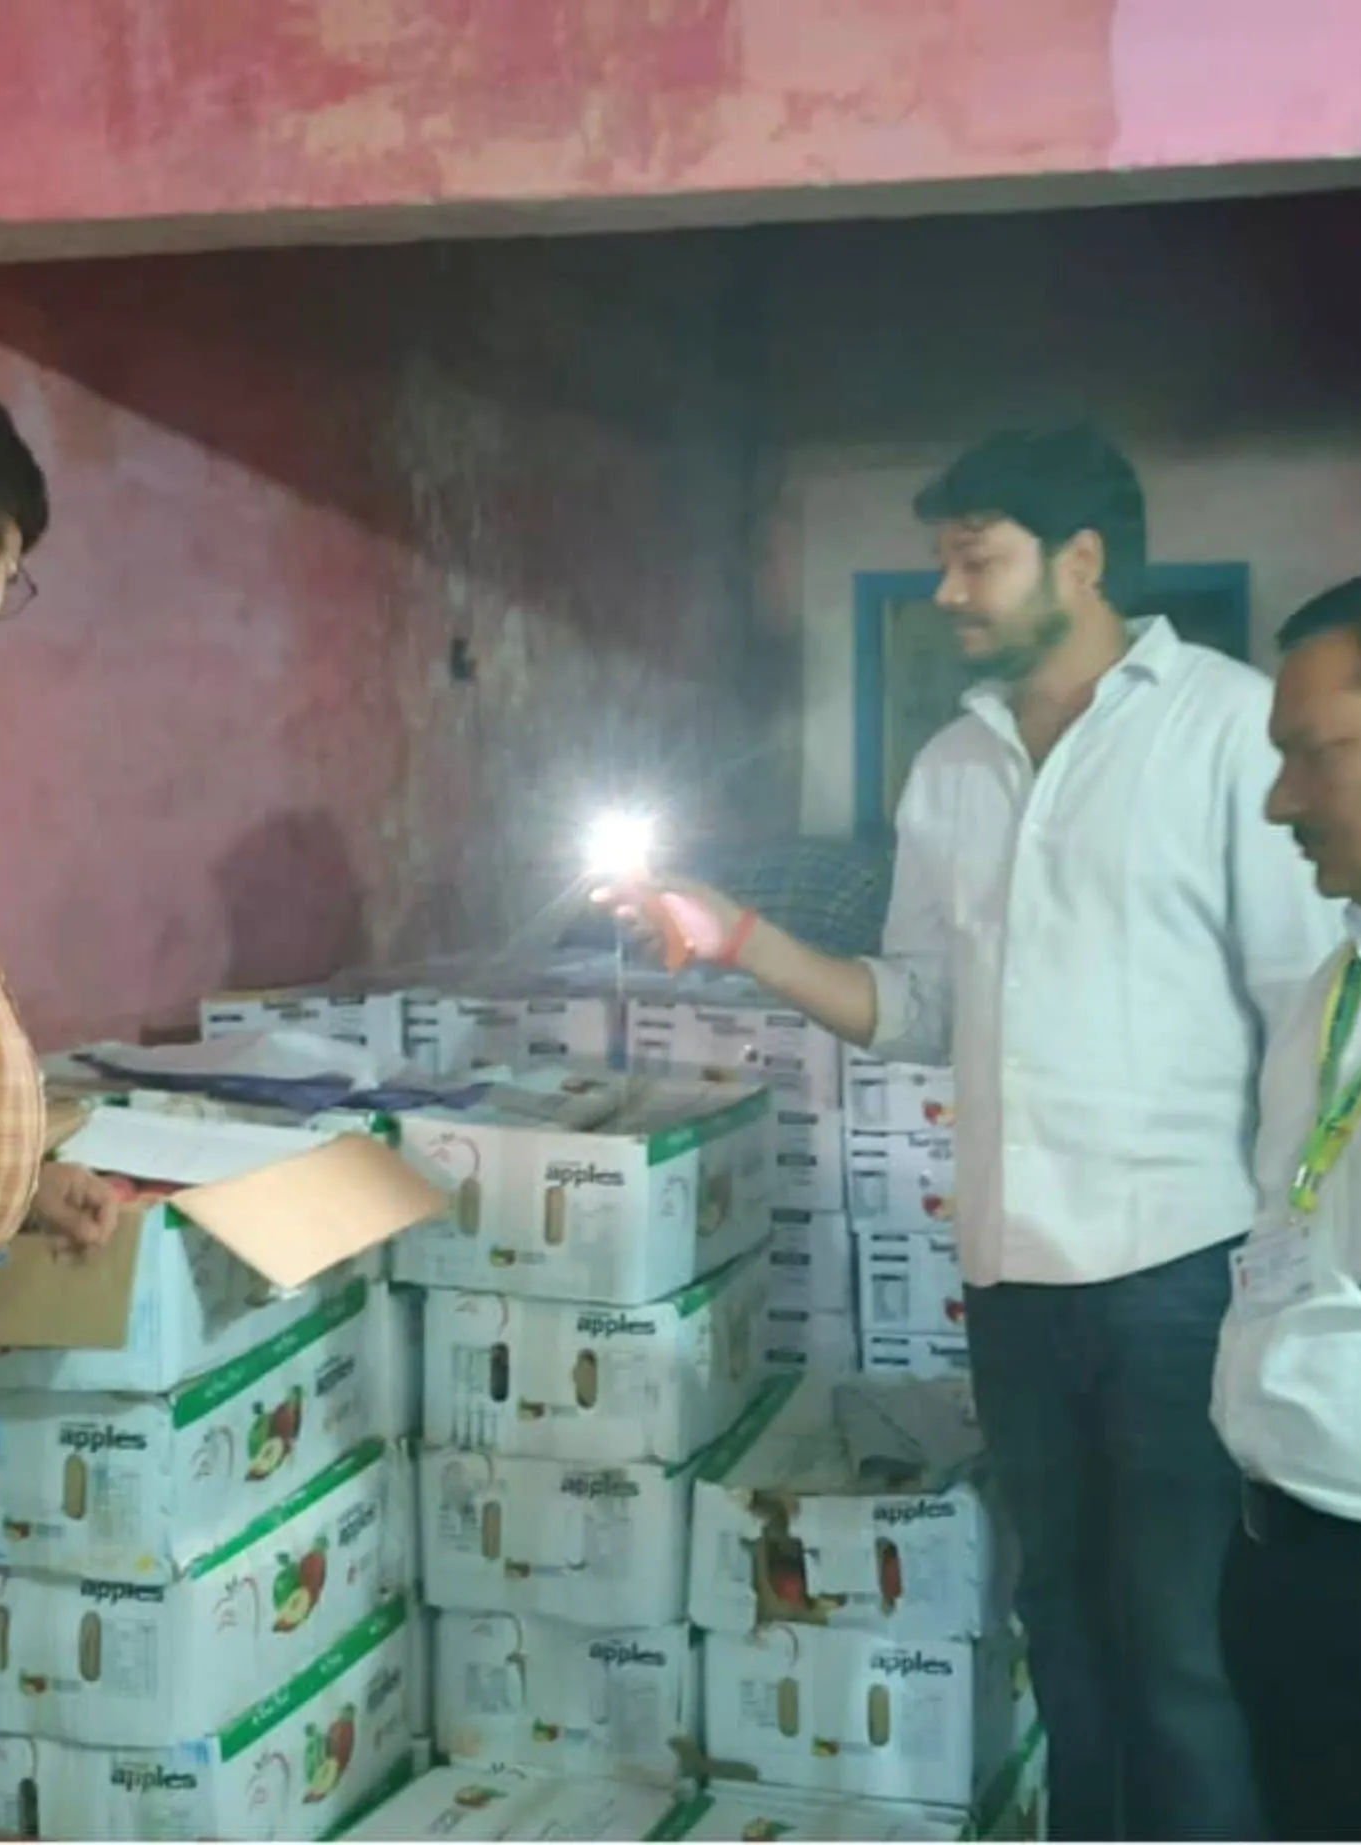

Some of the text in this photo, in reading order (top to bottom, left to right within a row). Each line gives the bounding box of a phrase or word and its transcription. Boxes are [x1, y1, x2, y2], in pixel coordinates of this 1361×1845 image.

[544, 1163, 625, 1188] apples
[577, 1313, 656, 1339] apples
[59, 1424, 148, 1453] apples
[873, 1499, 956, 1526] apples
[80, 1579, 166, 1607] apples
[589, 1640, 667, 1669] apples
[870, 1650, 954, 1678] apples
[110, 1763, 198, 1794] apples
